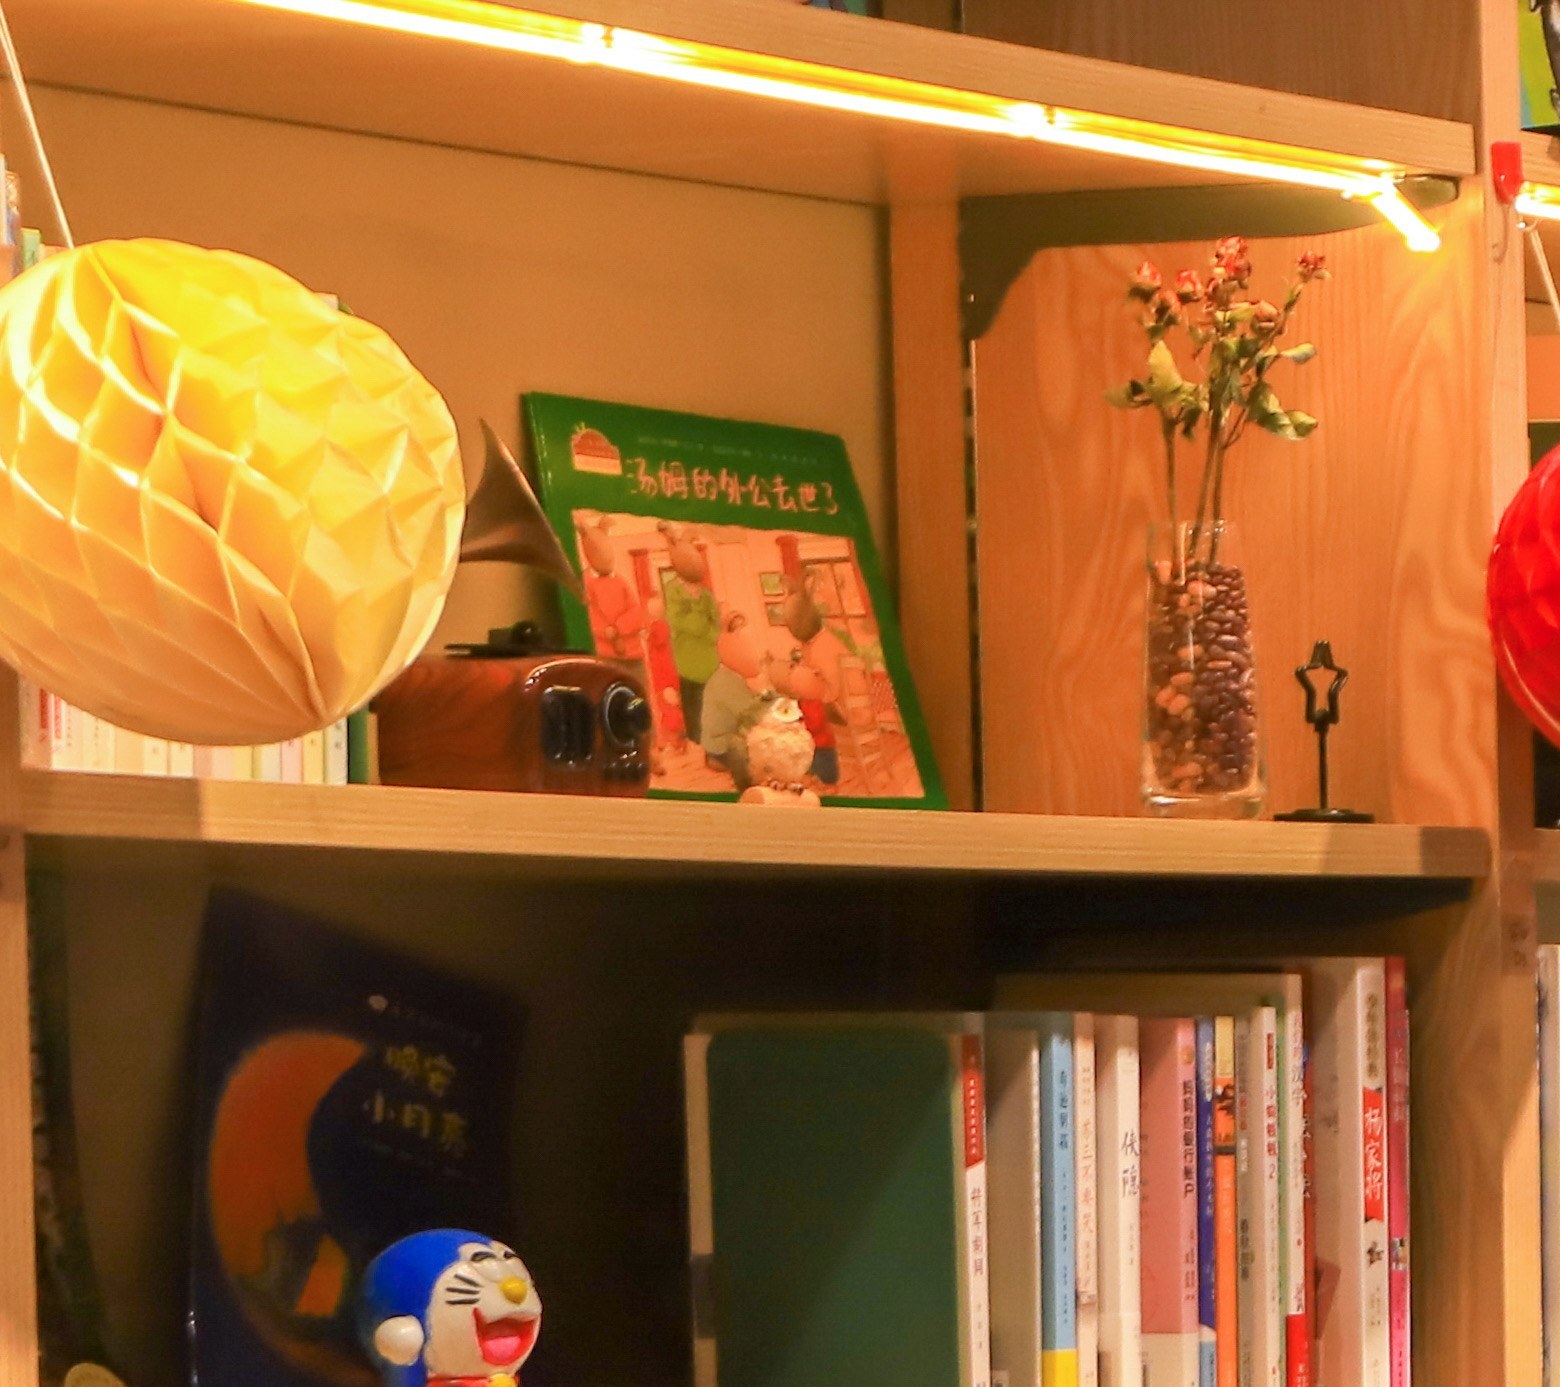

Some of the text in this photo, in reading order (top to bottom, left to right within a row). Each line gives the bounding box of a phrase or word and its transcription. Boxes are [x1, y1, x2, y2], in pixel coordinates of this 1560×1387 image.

[626, 457, 839, 515] 汤姆的外公去世了
[362, 1089, 470, 1160] 小月亮
[1365, 1107, 1382, 1201] 杨家将
[1121, 1130, 1140, 1198] 侠隐
